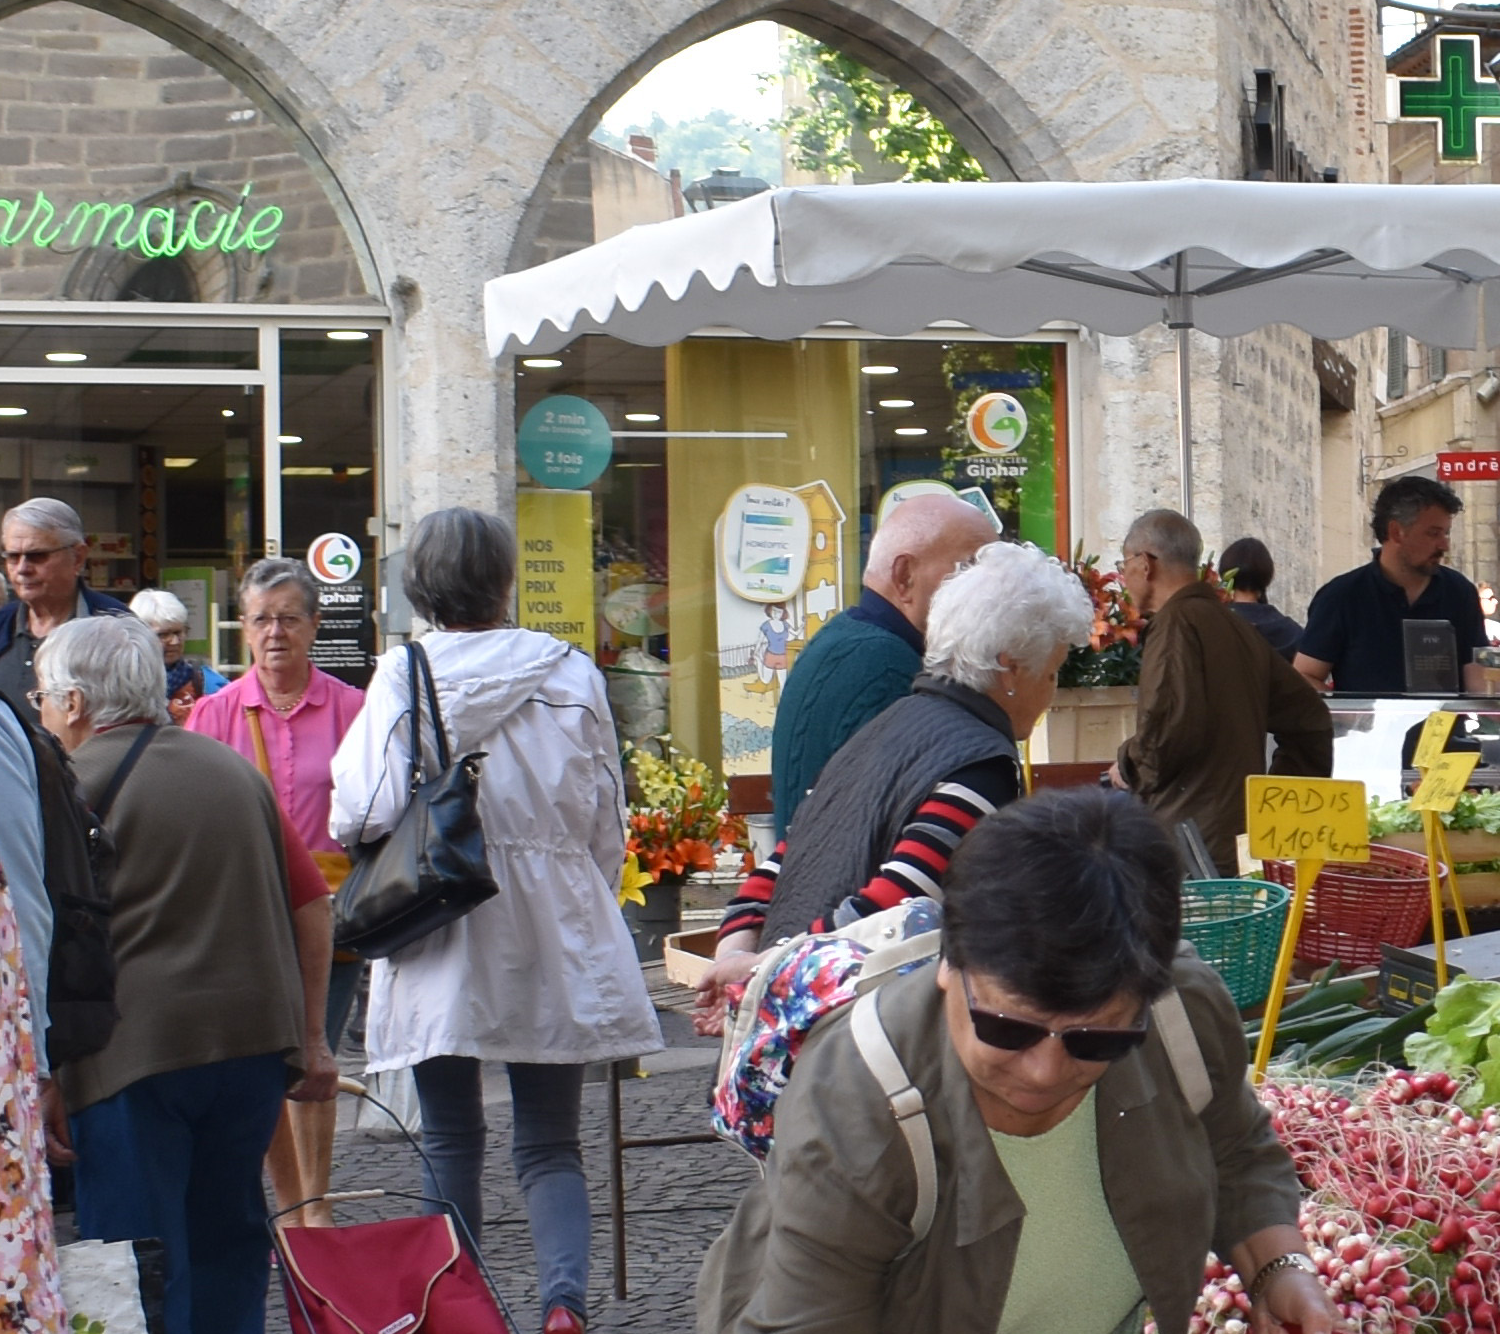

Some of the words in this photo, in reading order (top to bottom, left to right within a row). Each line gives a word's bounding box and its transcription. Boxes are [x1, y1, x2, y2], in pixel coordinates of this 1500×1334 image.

[544, 411, 554, 424] 2
[558, 412, 586, 425] min
[544, 451, 554, 463] 2
[557, 451, 584, 465] fois
[966, 464, 1028, 479] Giphar
[524, 540, 554, 553] NOS
[525, 560, 565, 573] PETITS
[525, 581, 556, 593] PRIX
[318, 592, 363, 605] iphar
[526, 601, 563, 614] VOUS
[526, 621, 585, 635] LAISSENT
[1258, 786, 1350, 814] RADIS
